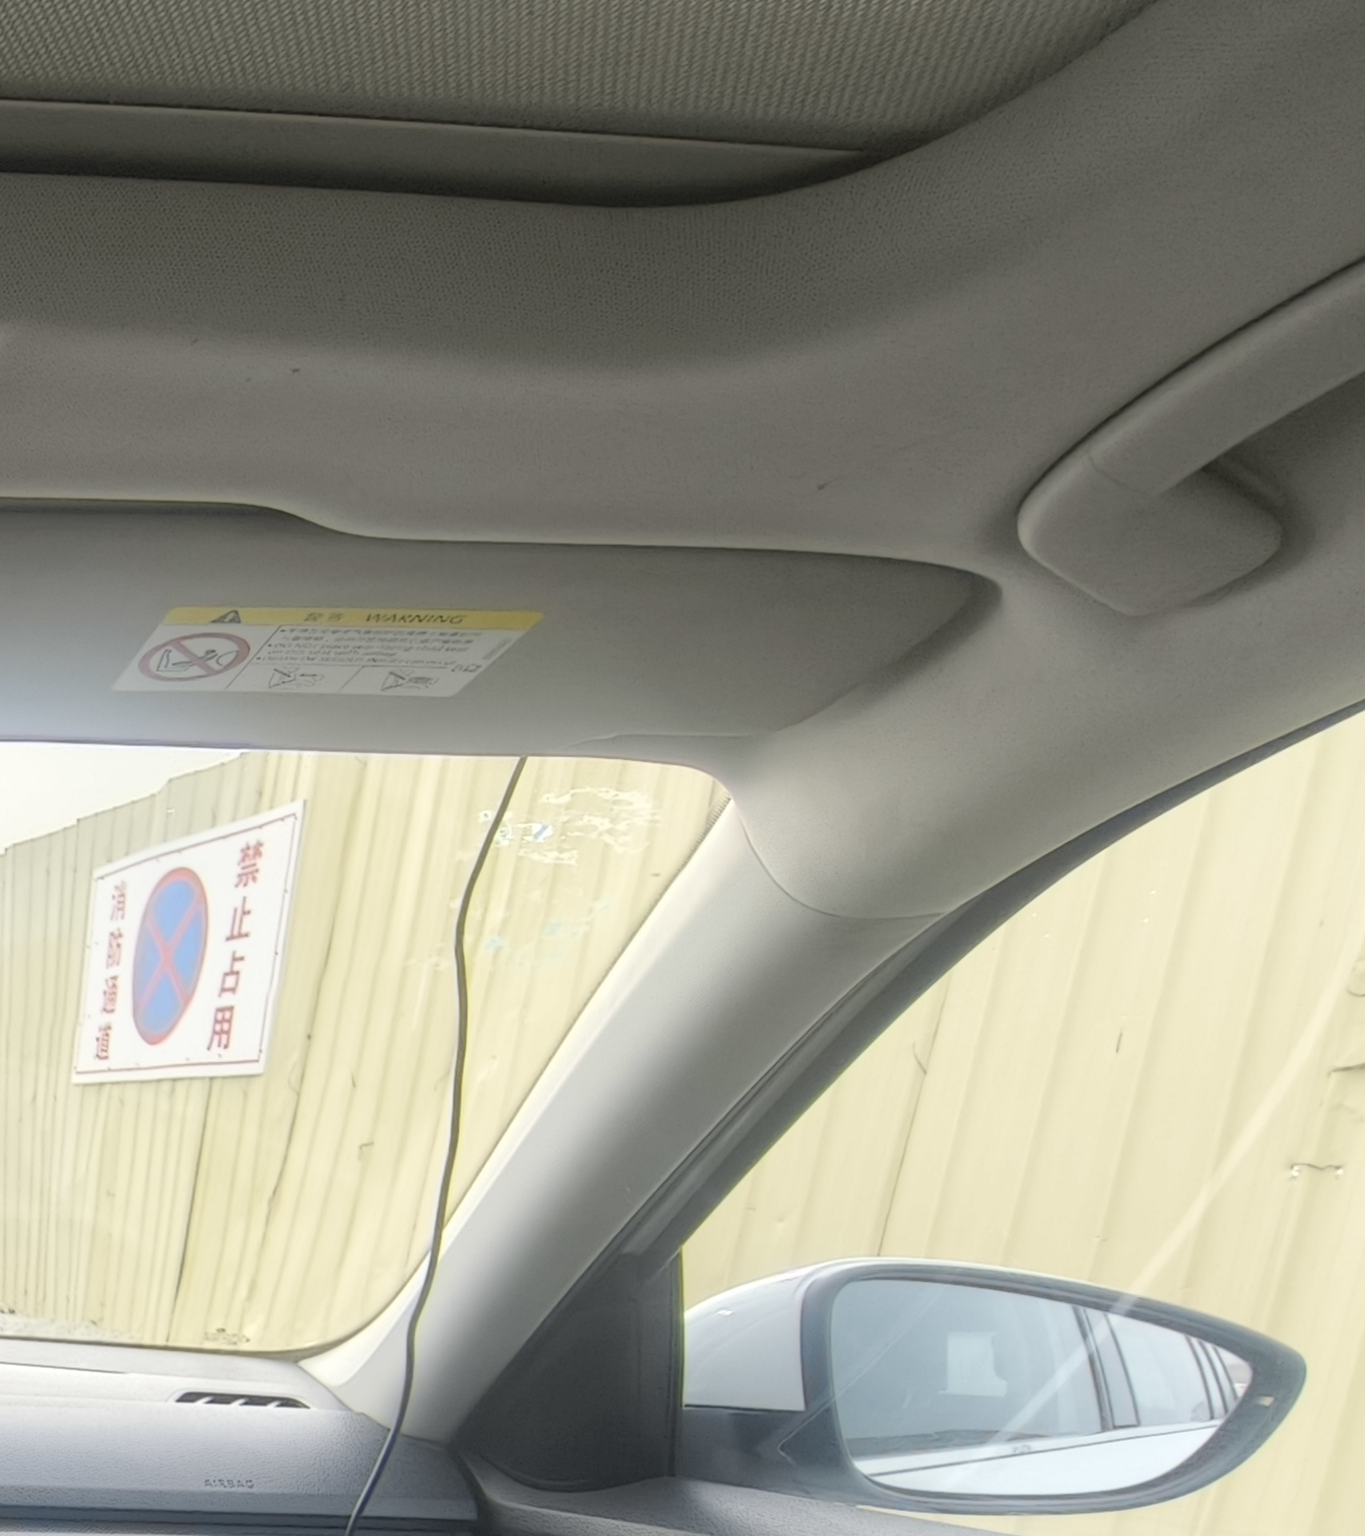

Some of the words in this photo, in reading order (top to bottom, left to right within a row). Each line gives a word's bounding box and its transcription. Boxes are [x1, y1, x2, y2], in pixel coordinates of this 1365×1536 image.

[365, 612, 468, 625] WARNING
[206, 839, 264, 1052] 禁止占用
[203, 1478, 256, 1490] AIRBAG
